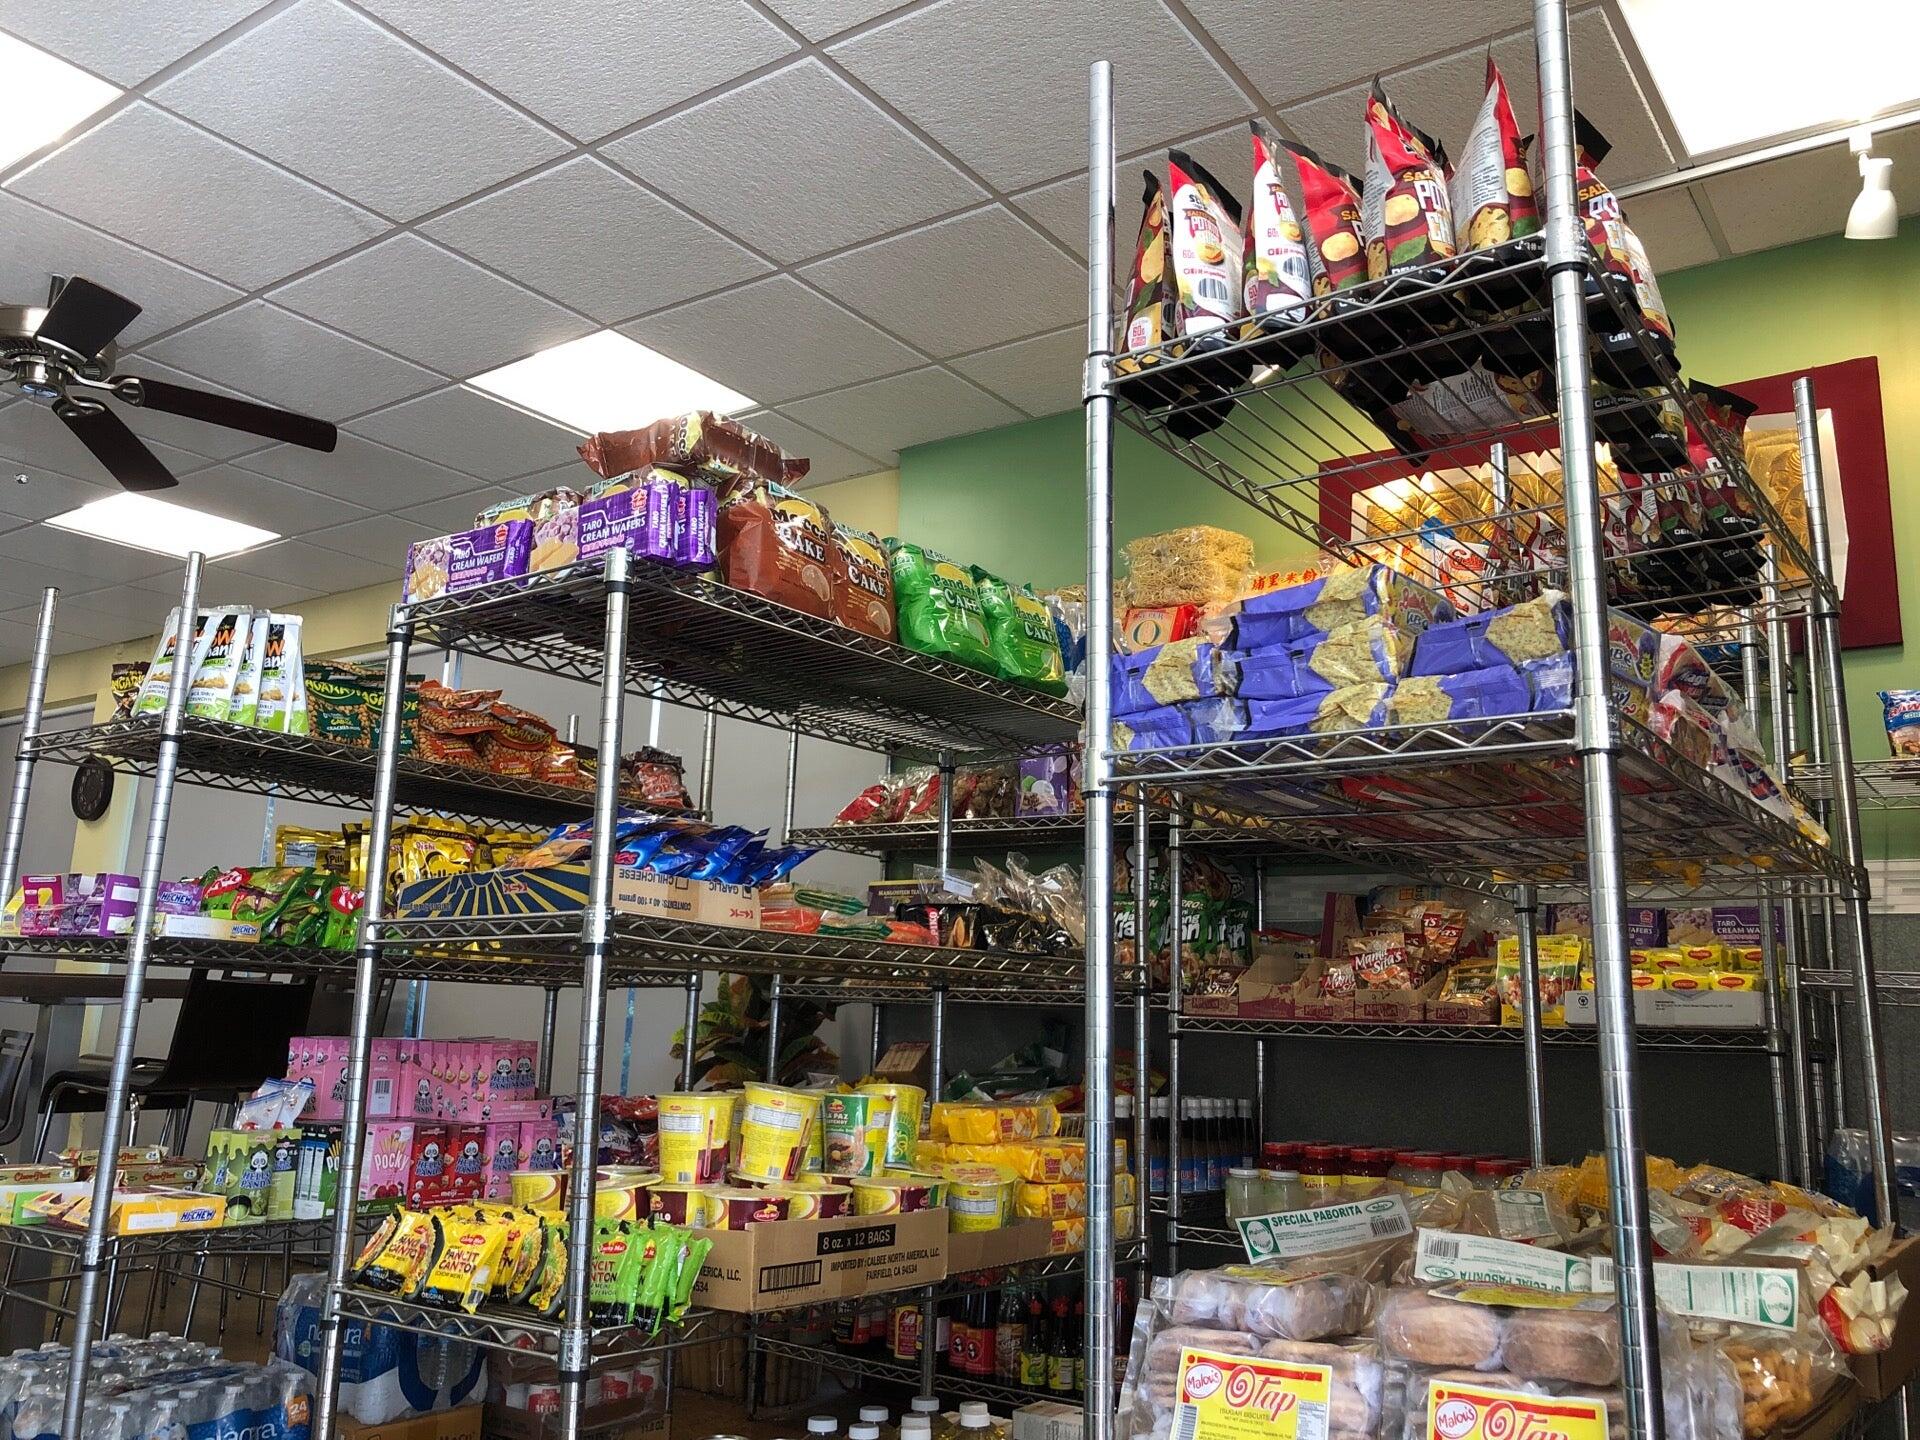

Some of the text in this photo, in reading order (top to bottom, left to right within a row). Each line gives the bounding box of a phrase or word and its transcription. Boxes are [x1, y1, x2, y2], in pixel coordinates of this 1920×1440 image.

[580, 516, 645, 544] CREAM WAFERS
[582, 518, 602, 532] TARO
[769, 507, 829, 544] Mocca
[777, 522, 826, 563] CAKE
[451, 552, 505, 572] CREAM WAFERS
[453, 547, 471, 561] TARO
[836, 543, 890, 580] Mocca
[847, 565, 887, 598] CAKE
[943, 587, 980, 616] CAKE
[1132, 618, 1162, 646] Q
[618, 868, 675, 887] CHILICHEESE
[708, 881, 739, 895] GARLIC
[1371, 951, 1403, 973] Sita's
[374, 1151, 410, 1173] POCKY
[1271, 1204, 1363, 1227] SPECIAL PABORITA
[822, 1236, 830, 1250] 8
[831, 1239, 843, 1249] oz.
[854, 1233, 865, 1246] 12
[867, 1229, 891, 1244] BAGS
[830, 1259, 857, 1271] IMPORTED
[867, 1256, 887, 1268] CALBEE
[887, 1253, 905, 1265] NORTH
[893, 1267, 901, 1276] CA
[901, 1264, 918, 1276] 94534
[726, 1268, 742, 1282] LLC.
[289, 1401, 307, 1415] 24
